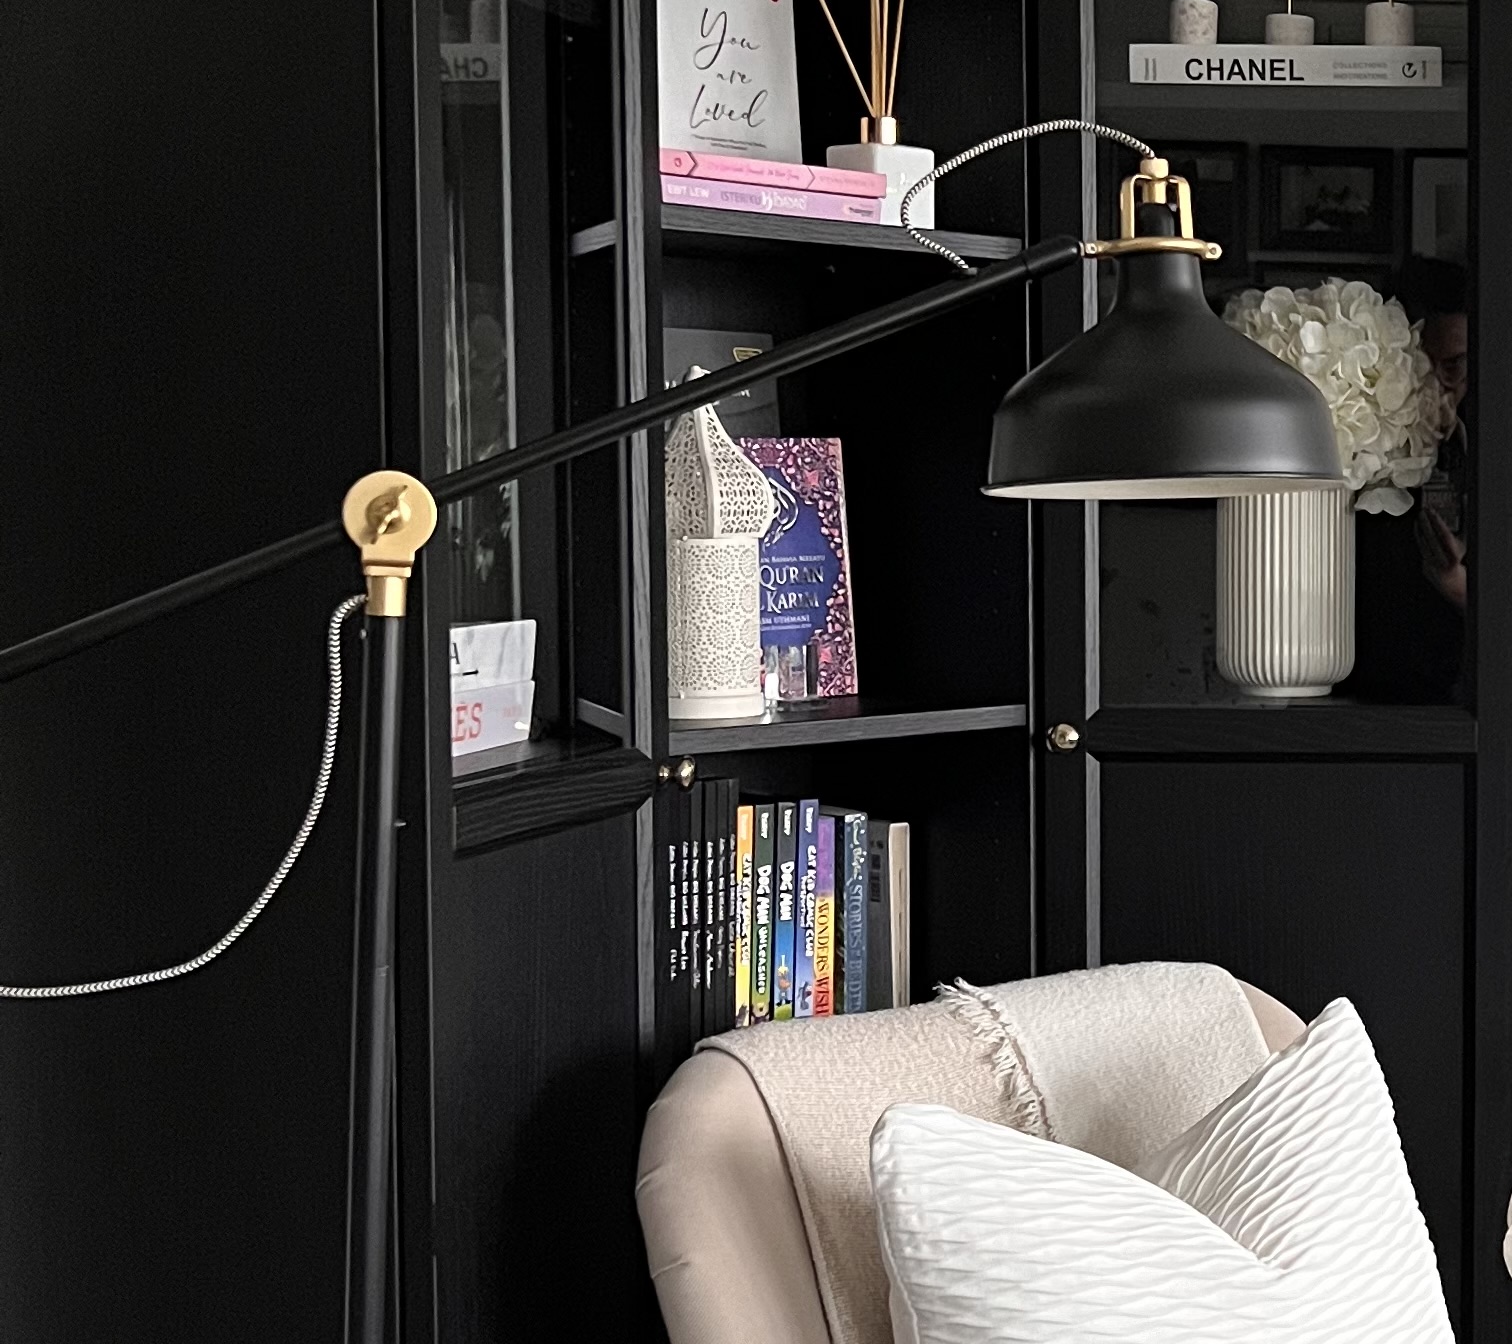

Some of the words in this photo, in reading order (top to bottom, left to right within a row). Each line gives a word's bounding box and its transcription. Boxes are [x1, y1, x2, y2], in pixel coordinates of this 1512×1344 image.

[693, 8, 760, 70] You
[716, 71, 752, 84] are
[1184, 58, 1305, 82] CHANEL
[689, 84, 768, 129] Loved
[766, 590, 820, 614] KARIM
[807, 845, 817, 867] CAT
[756, 864, 772, 895] DOG
[779, 861, 795, 891] DOG
[756, 896, 770, 925] MAN
[779, 892, 794, 921] MAN
[849, 884, 863, 949] STORIES
[804, 930, 814, 957] CLUB
[816, 902, 830, 973] WONDERS
